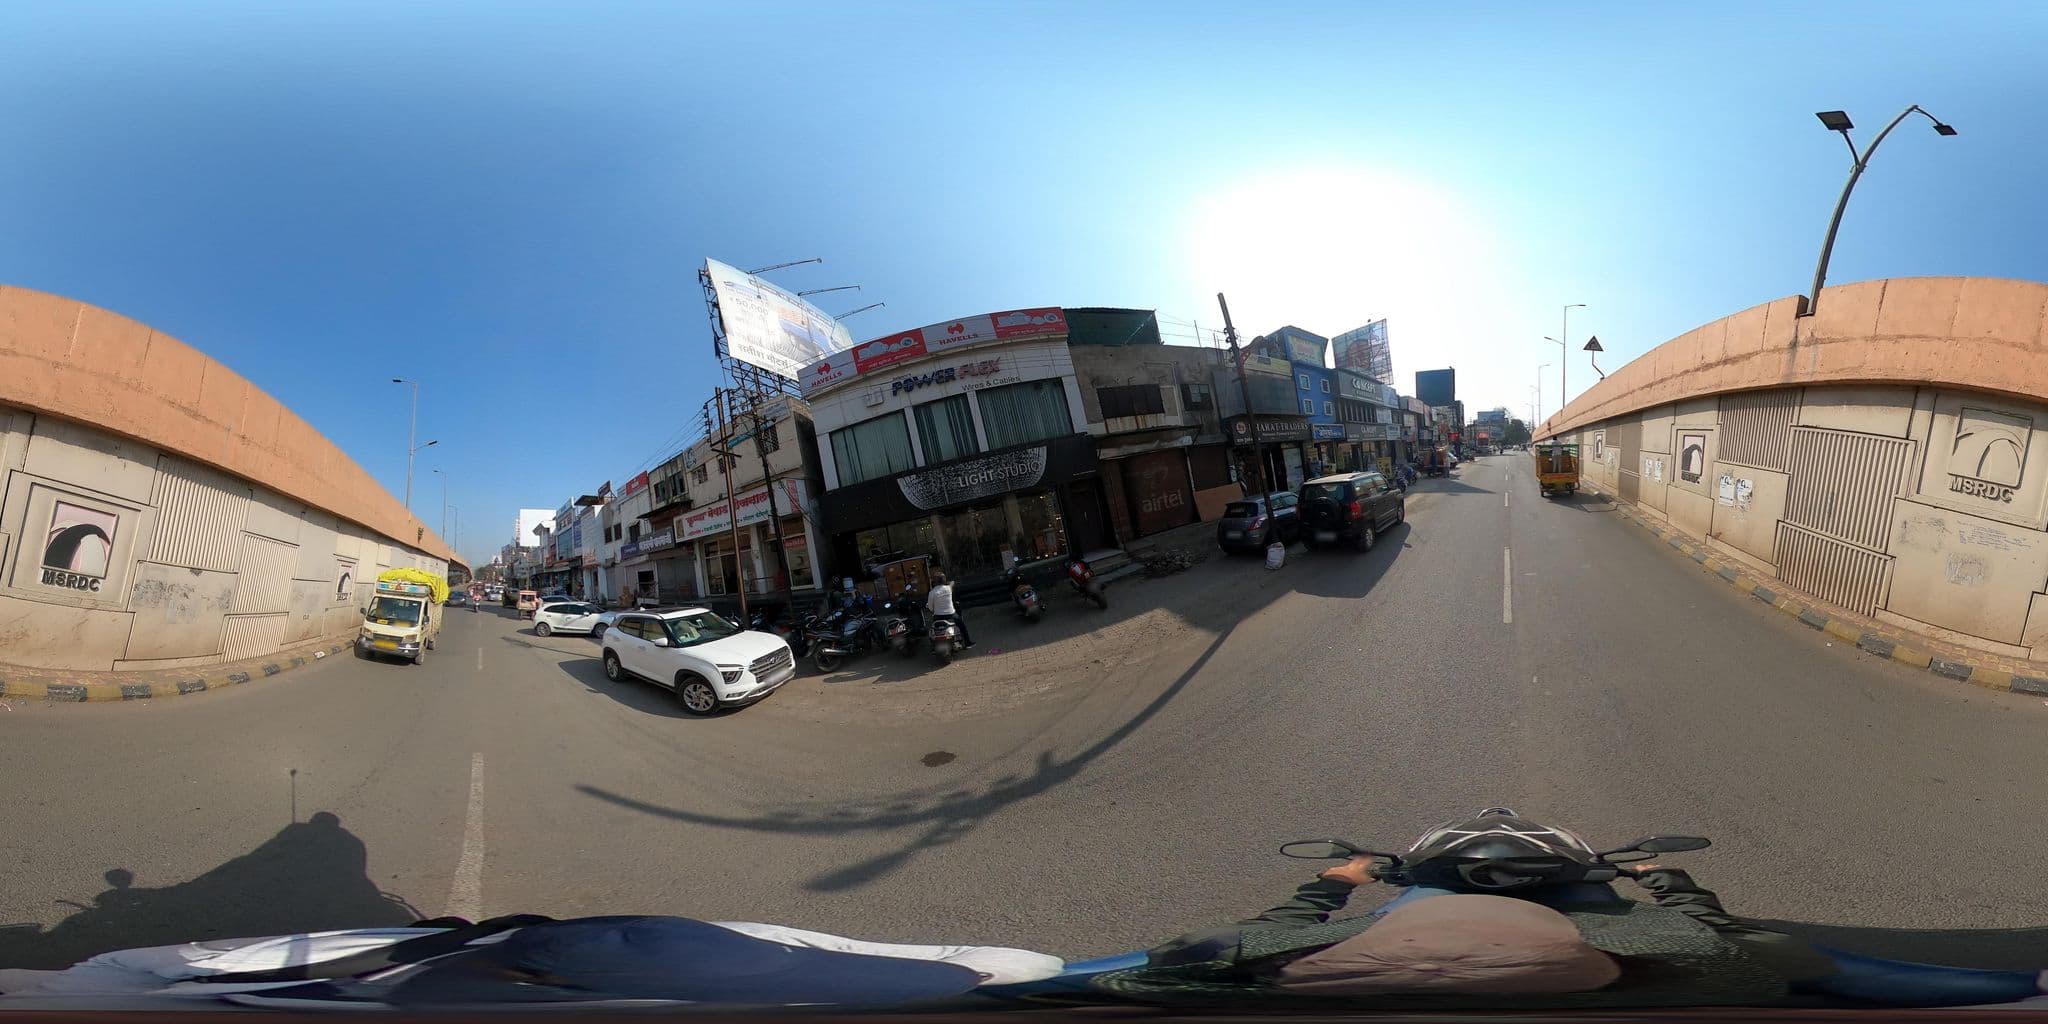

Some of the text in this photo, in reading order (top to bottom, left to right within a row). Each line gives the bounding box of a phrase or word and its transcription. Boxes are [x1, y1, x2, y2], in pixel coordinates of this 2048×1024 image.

[939, 332, 979, 346] HAVELLS
[811, 371, 842, 388] HAVELLS
[892, 356, 1001, 396] POWER FLEX
[992, 375, 1022, 386] Cables
[959, 460, 1042, 488] LIGHT STUDIO
[1141, 489, 1185, 513] airtel
[1950, 475, 2014, 504] MSRDC
[42, 570, 101, 592] MSRDC
